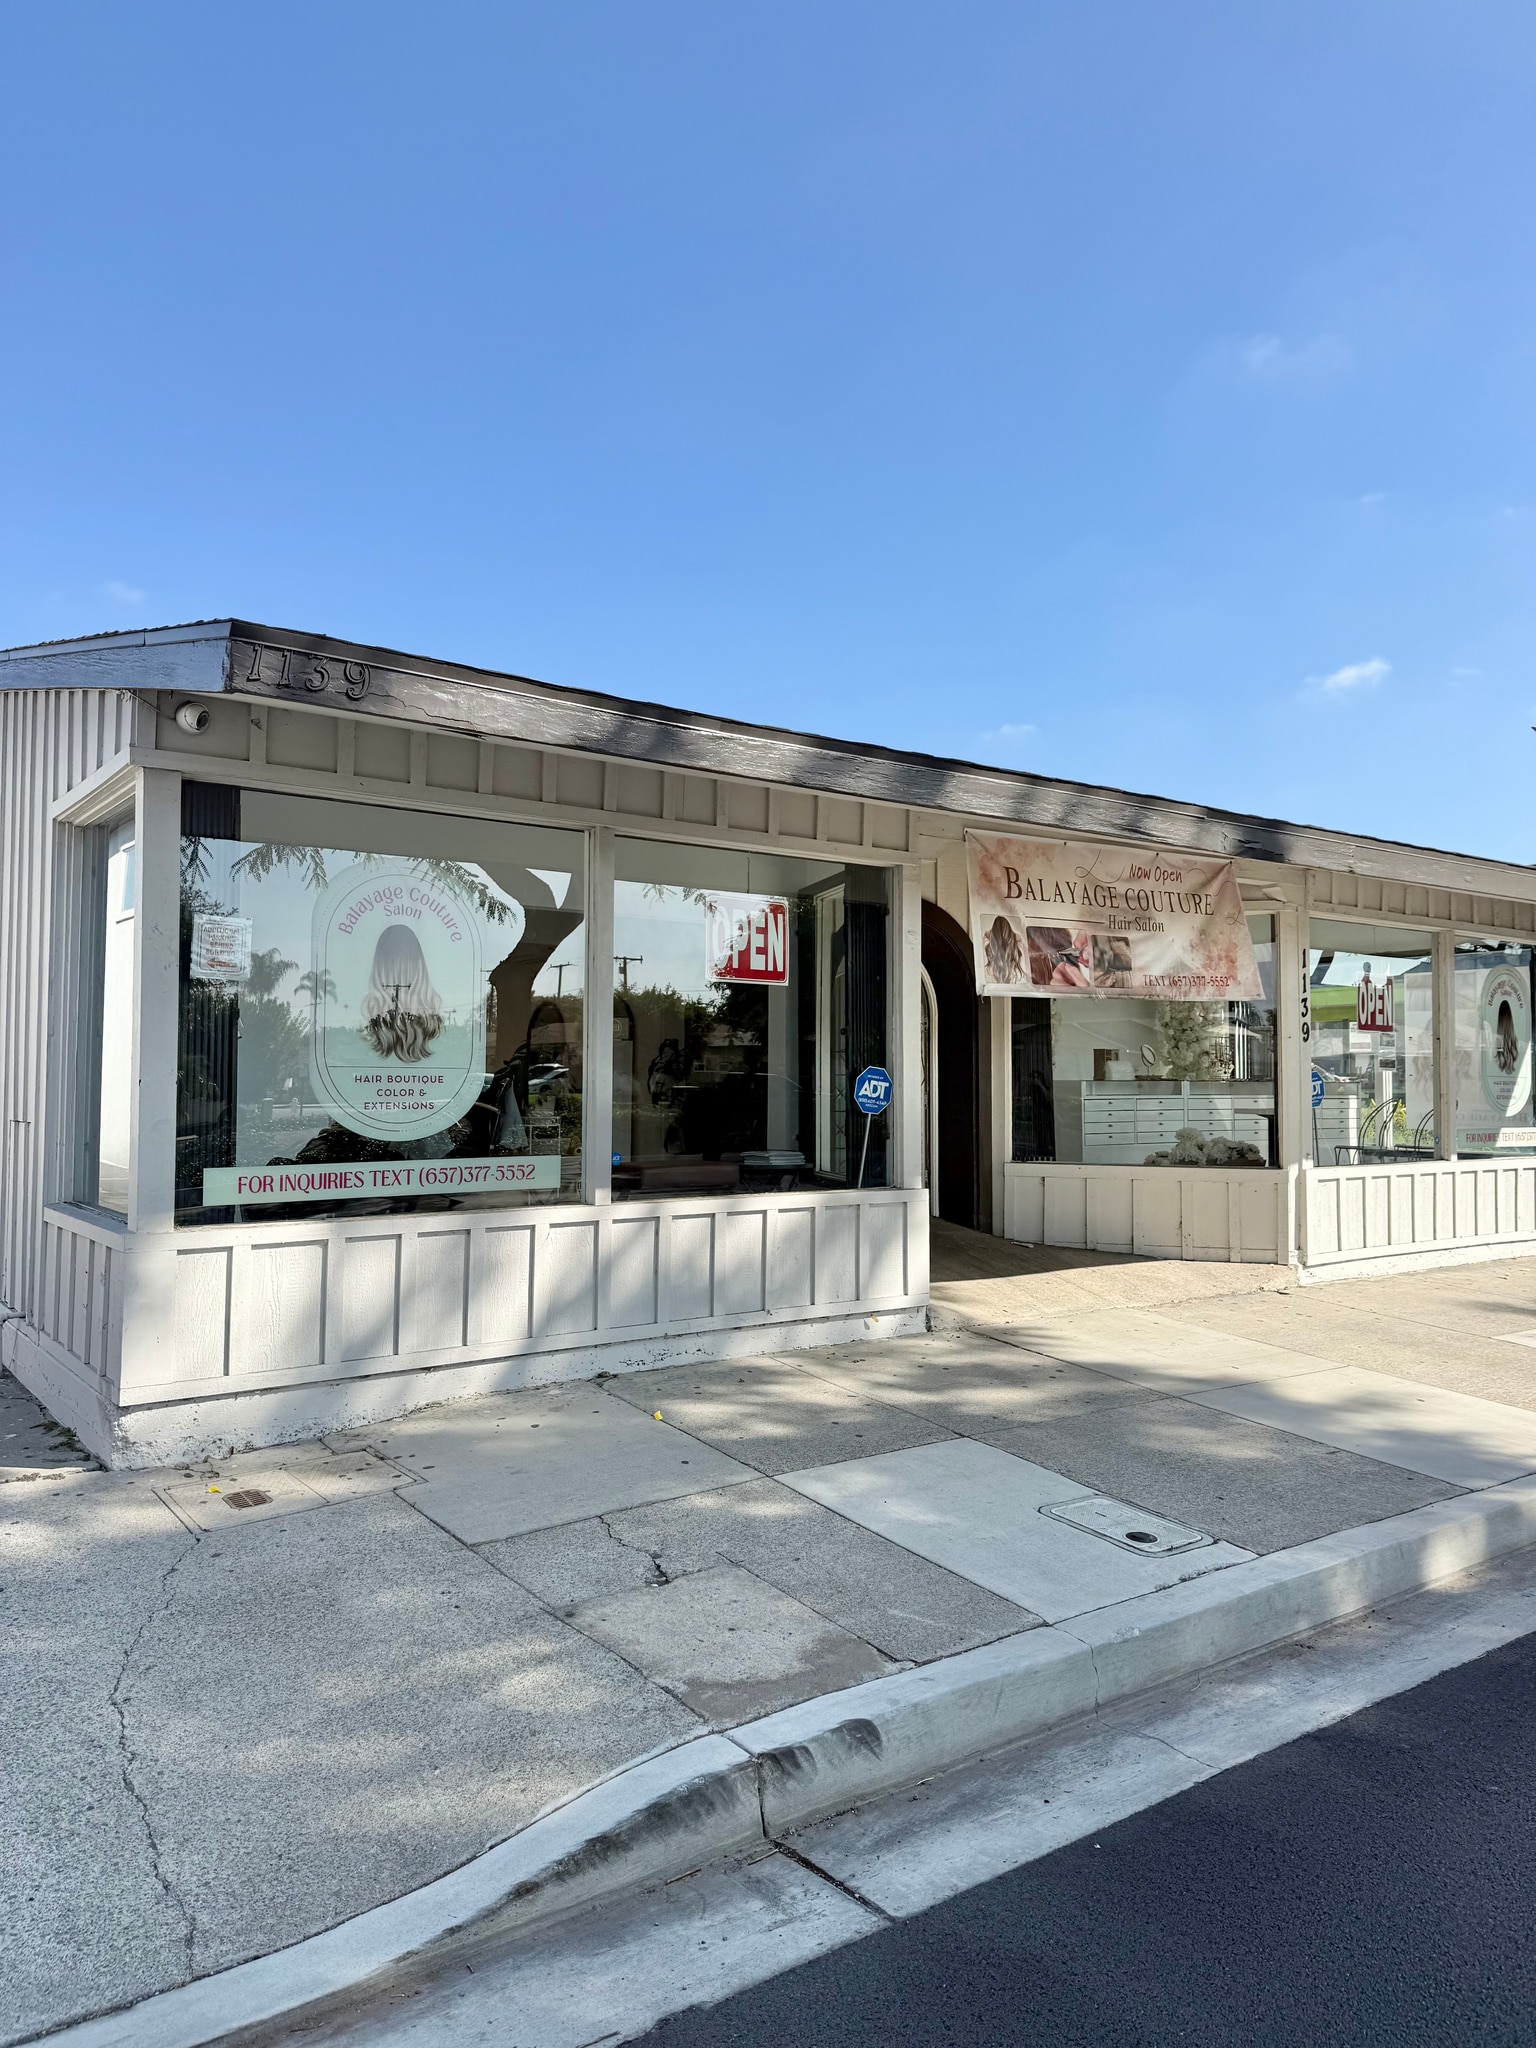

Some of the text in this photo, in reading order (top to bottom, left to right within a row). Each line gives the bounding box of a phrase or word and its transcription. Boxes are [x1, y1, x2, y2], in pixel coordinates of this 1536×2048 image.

[246, 643, 371, 699] 1139
[1129, 863, 1183, 886] Now Open
[1003, 866, 1214, 916] BALAYAGE COUTURE
[338, 886, 462, 942] Balayage Couture
[383, 904, 422, 920] Salon
[1108, 915, 1165, 933] Hair Salon
[712, 906, 784, 972] OPEN
[1143, 975, 1230, 989] TEXT (657)377-5552
[1301, 949, 1310, 1042] 1139
[1358, 981, 1393, 1026] OPEN
[354, 1074, 444, 1085] HAIR BOUTIQUE
[858, 1080, 890, 1099] ADT
[1311, 1081, 1322, 1096] DT
[376, 1088, 427, 1097] COLOR &
[364, 1101, 435, 1111] EXTENSIONS
[238, 1164, 536, 1194] FOR INQUIRIES TEXT (657)377-5552
